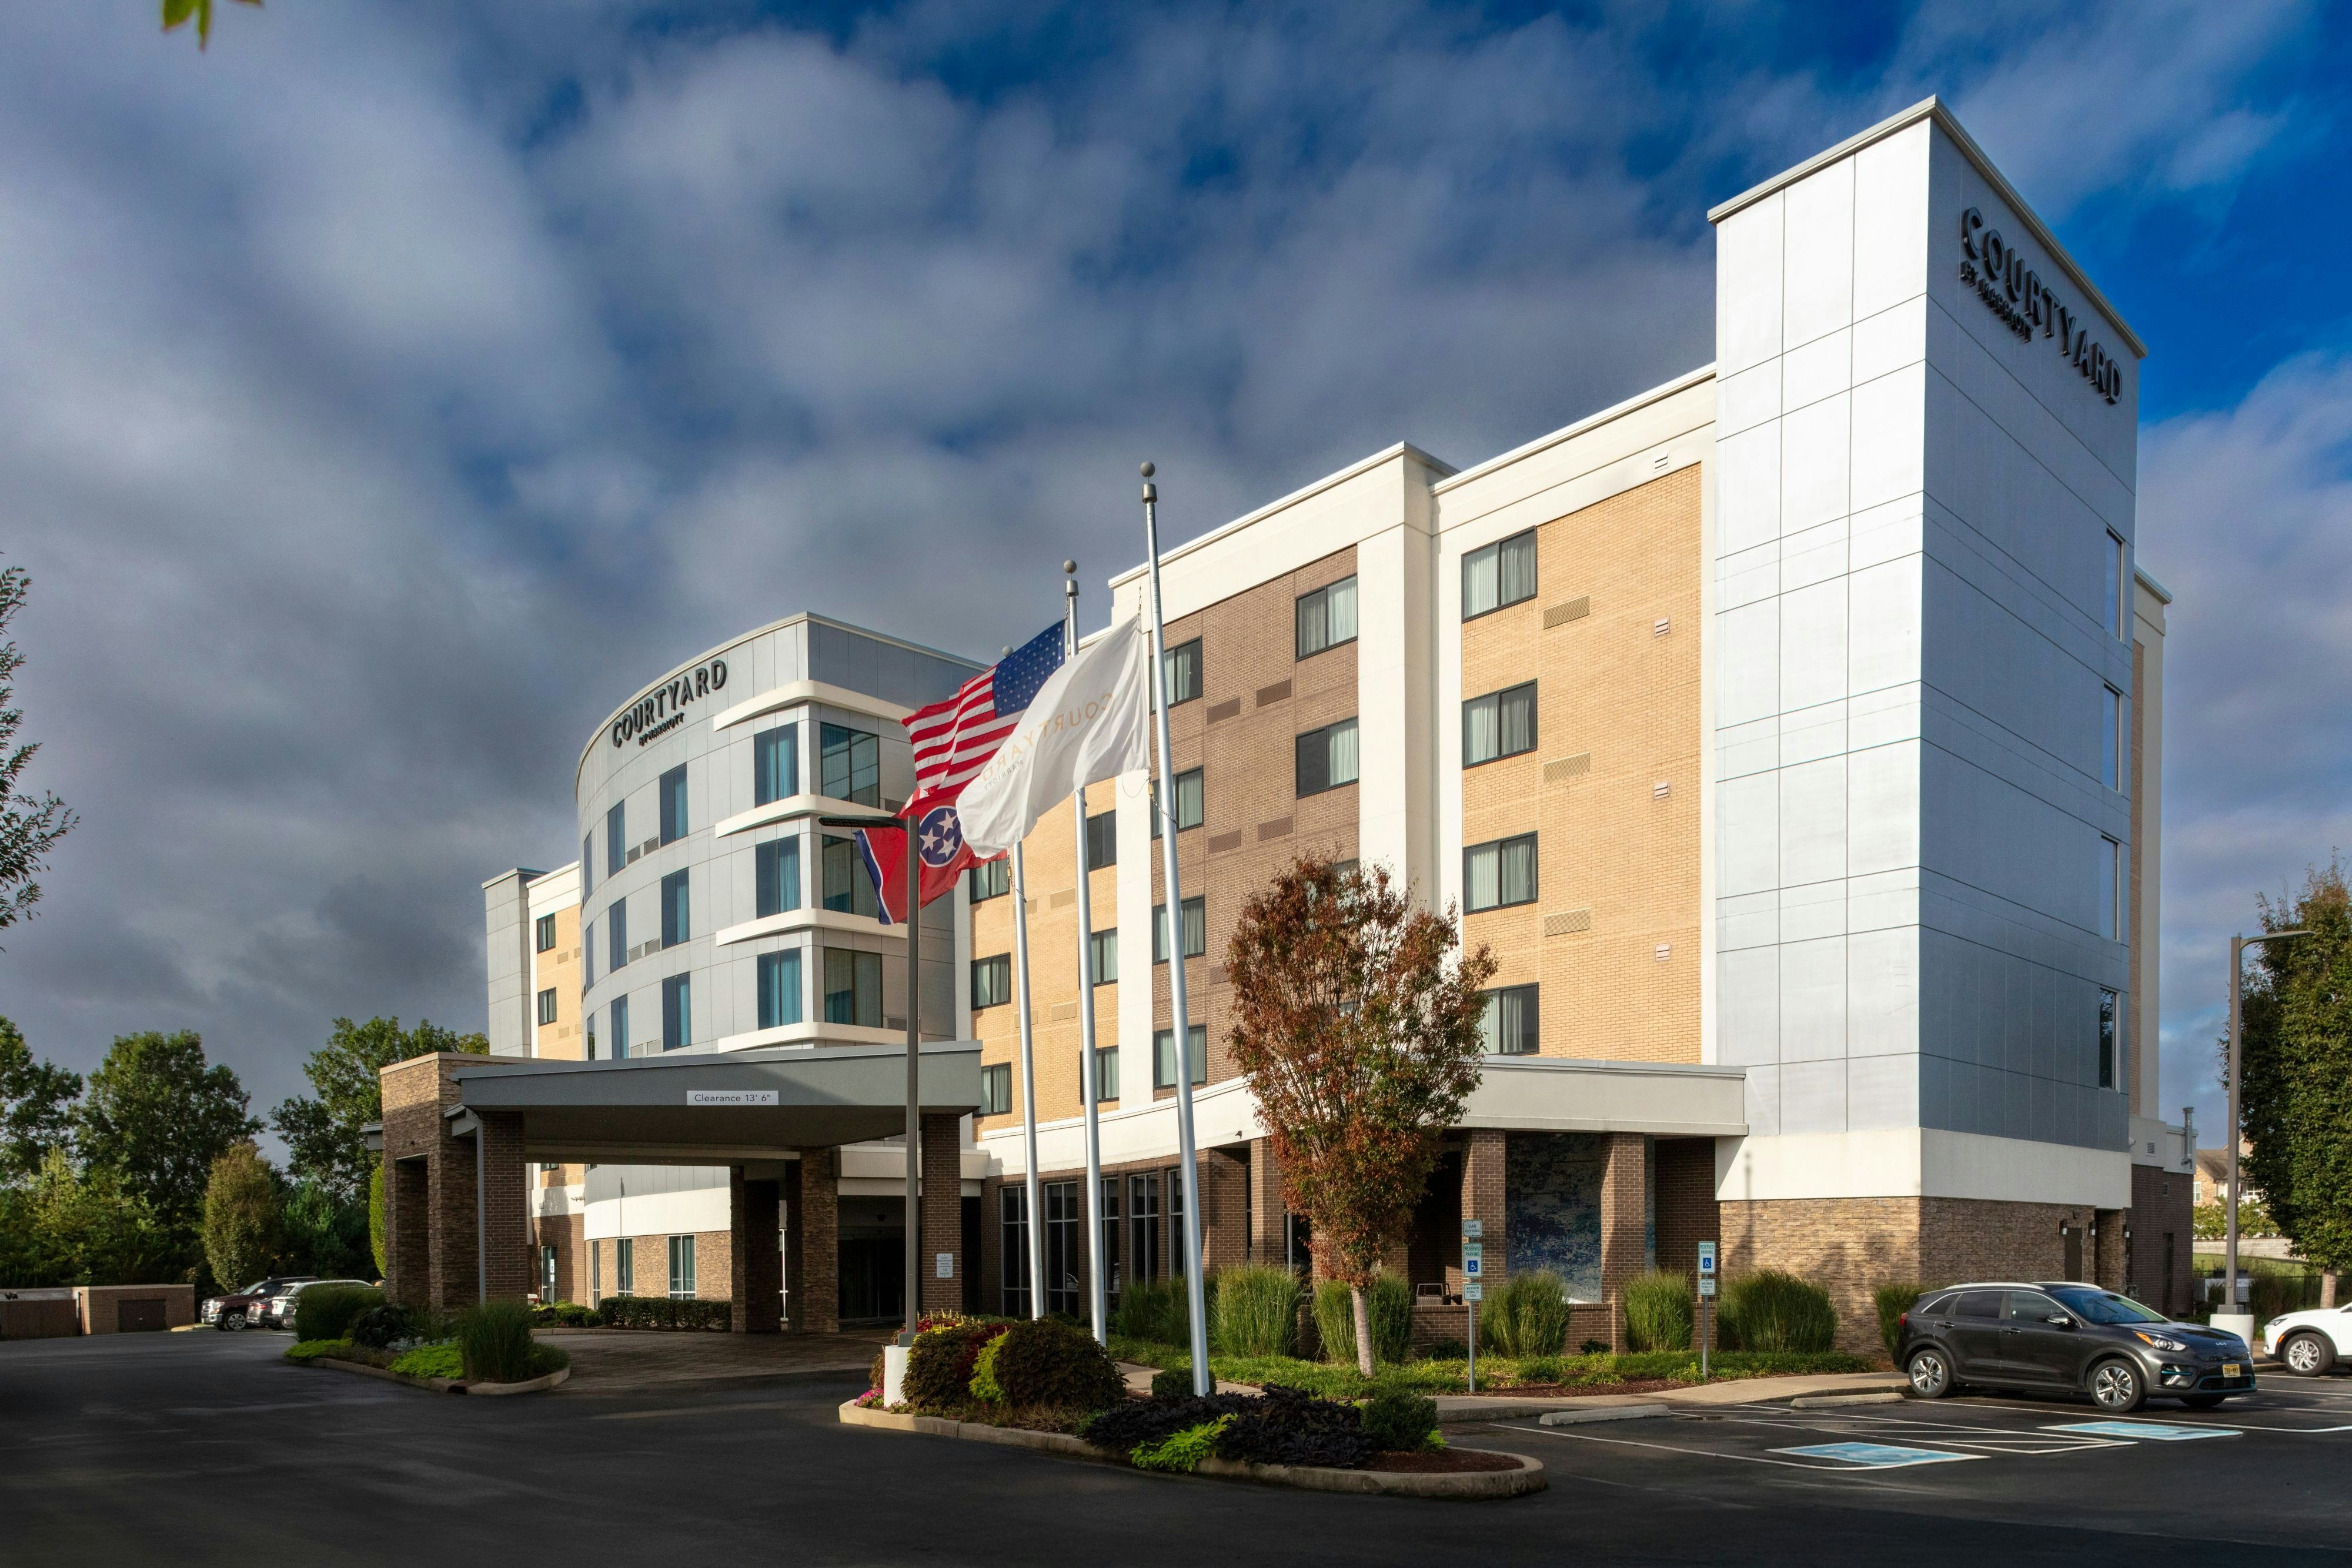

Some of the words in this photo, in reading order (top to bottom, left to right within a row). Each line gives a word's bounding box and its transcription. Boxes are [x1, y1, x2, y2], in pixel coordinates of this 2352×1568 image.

[1962, 207, 2123, 405] COURTYARD
[612, 660, 727, 748] COURTYARD
[648, 712, 685, 741] MARRIOTT
[694, 1094, 741, 1102] Clearance
